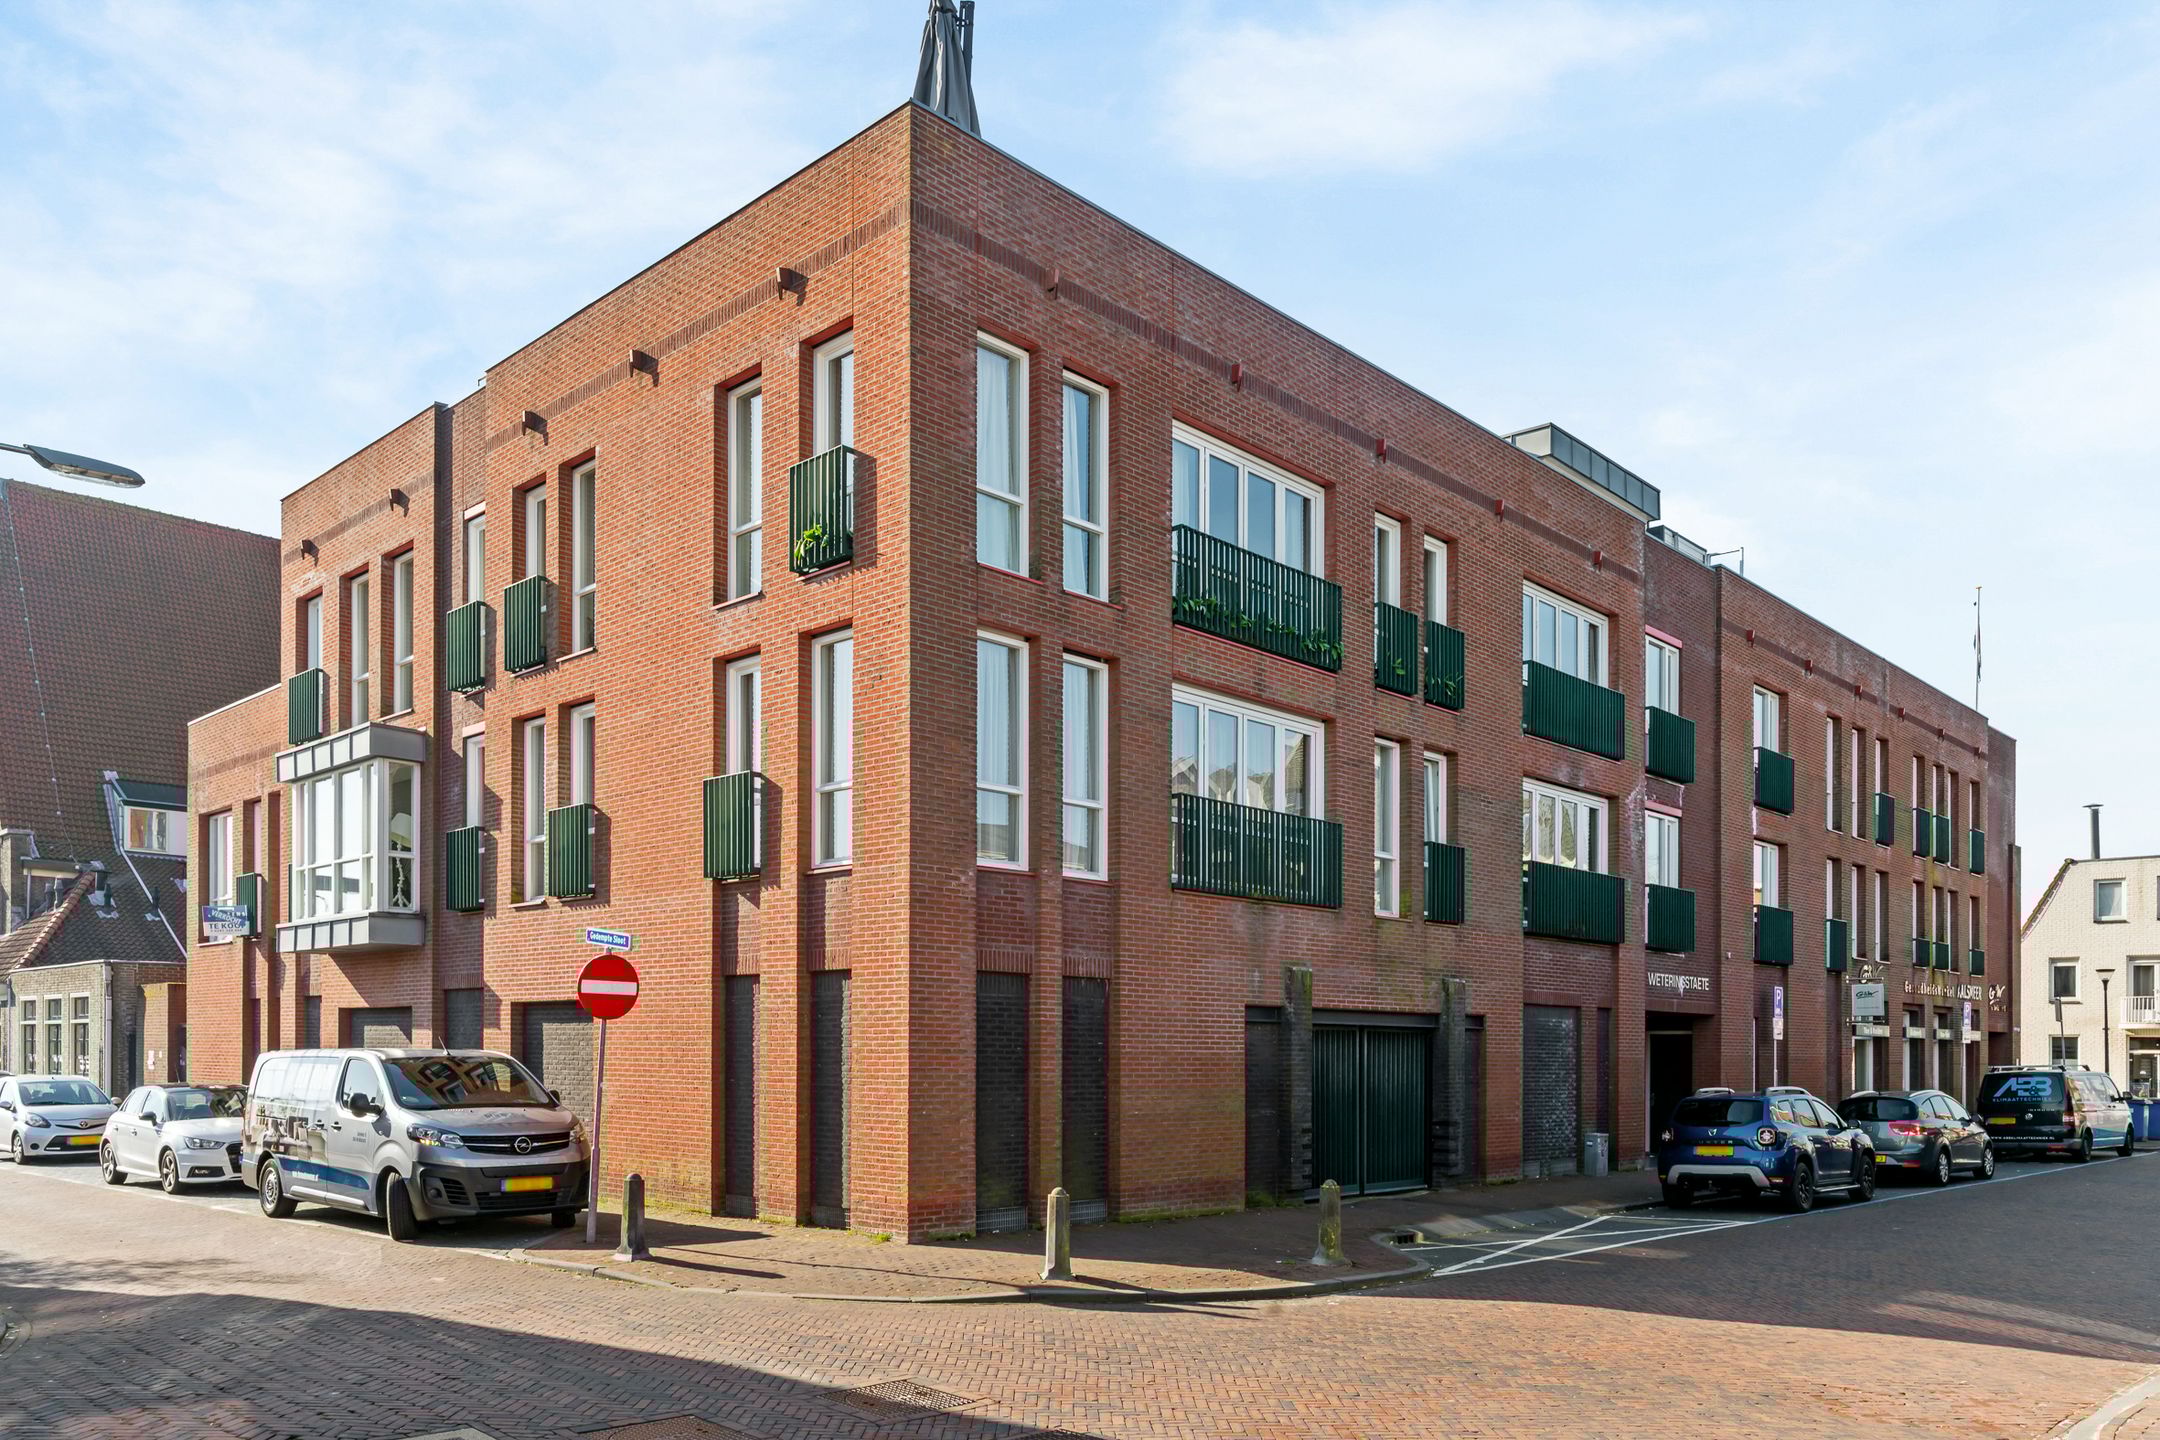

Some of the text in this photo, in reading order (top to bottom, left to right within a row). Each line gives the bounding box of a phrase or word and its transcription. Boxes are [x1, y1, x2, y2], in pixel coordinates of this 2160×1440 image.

[590, 931, 626, 944] Gedempte Sloot
[1957, 984, 1982, 1000] AALSMEER
